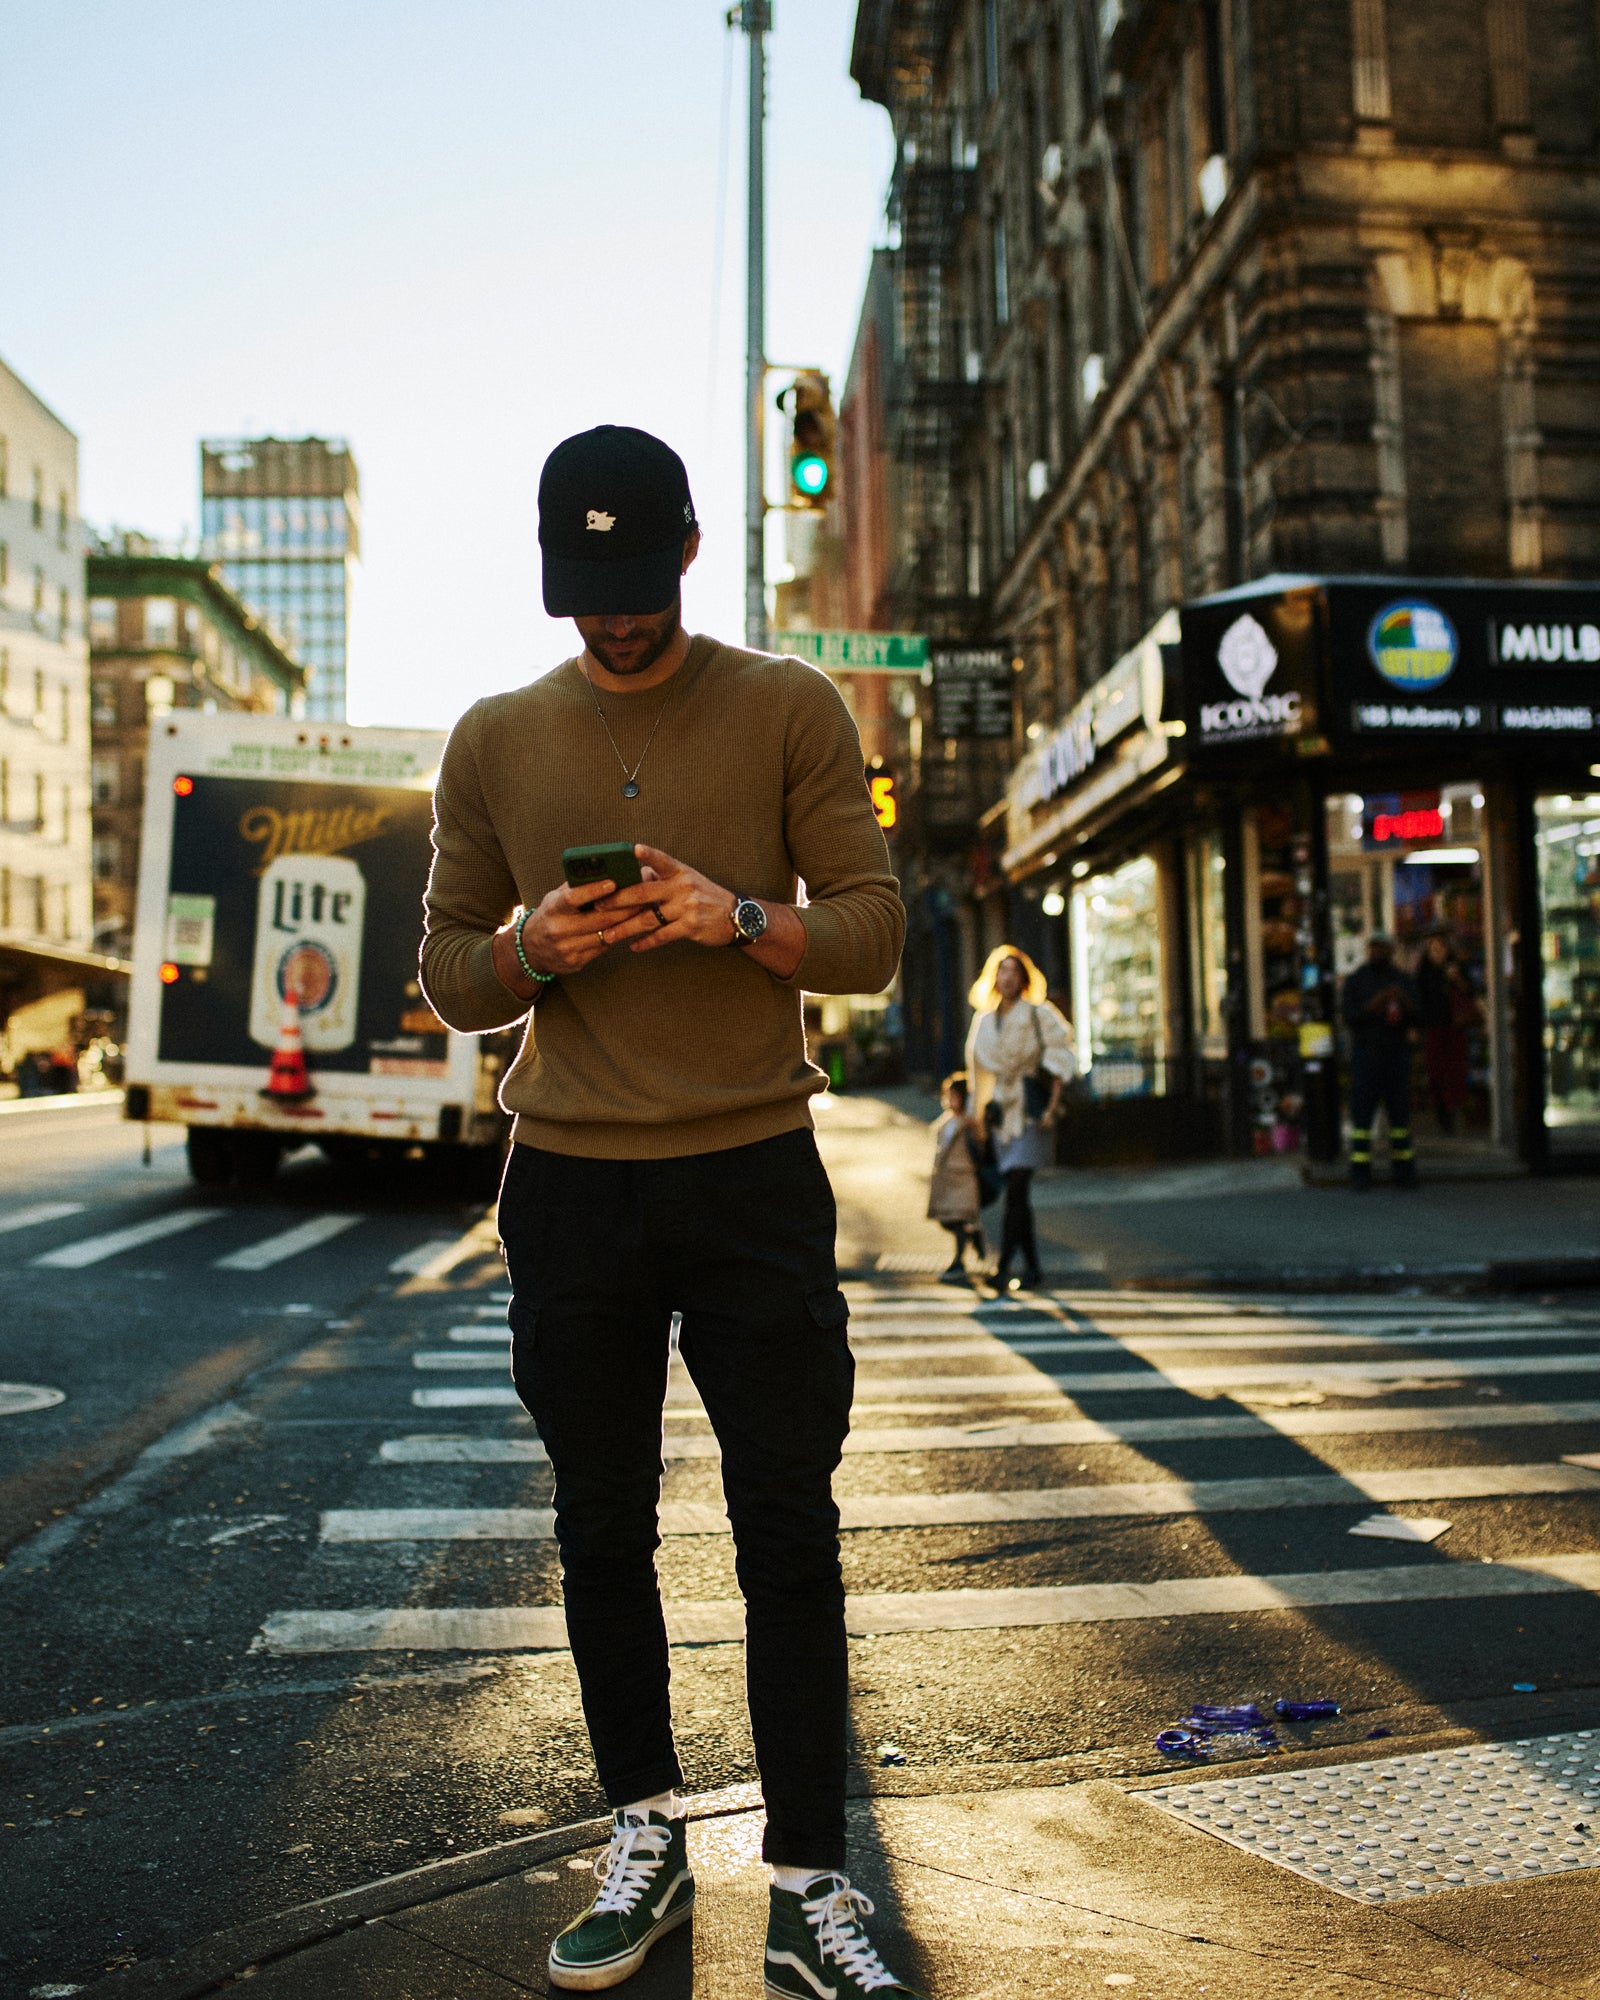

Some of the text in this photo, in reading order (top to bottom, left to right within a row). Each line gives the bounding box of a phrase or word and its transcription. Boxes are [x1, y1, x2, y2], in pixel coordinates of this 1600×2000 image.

[1200, 692, 1302, 731] ICONIC
[239, 804, 394, 876] Miller
[273, 879, 352, 933] Lite
